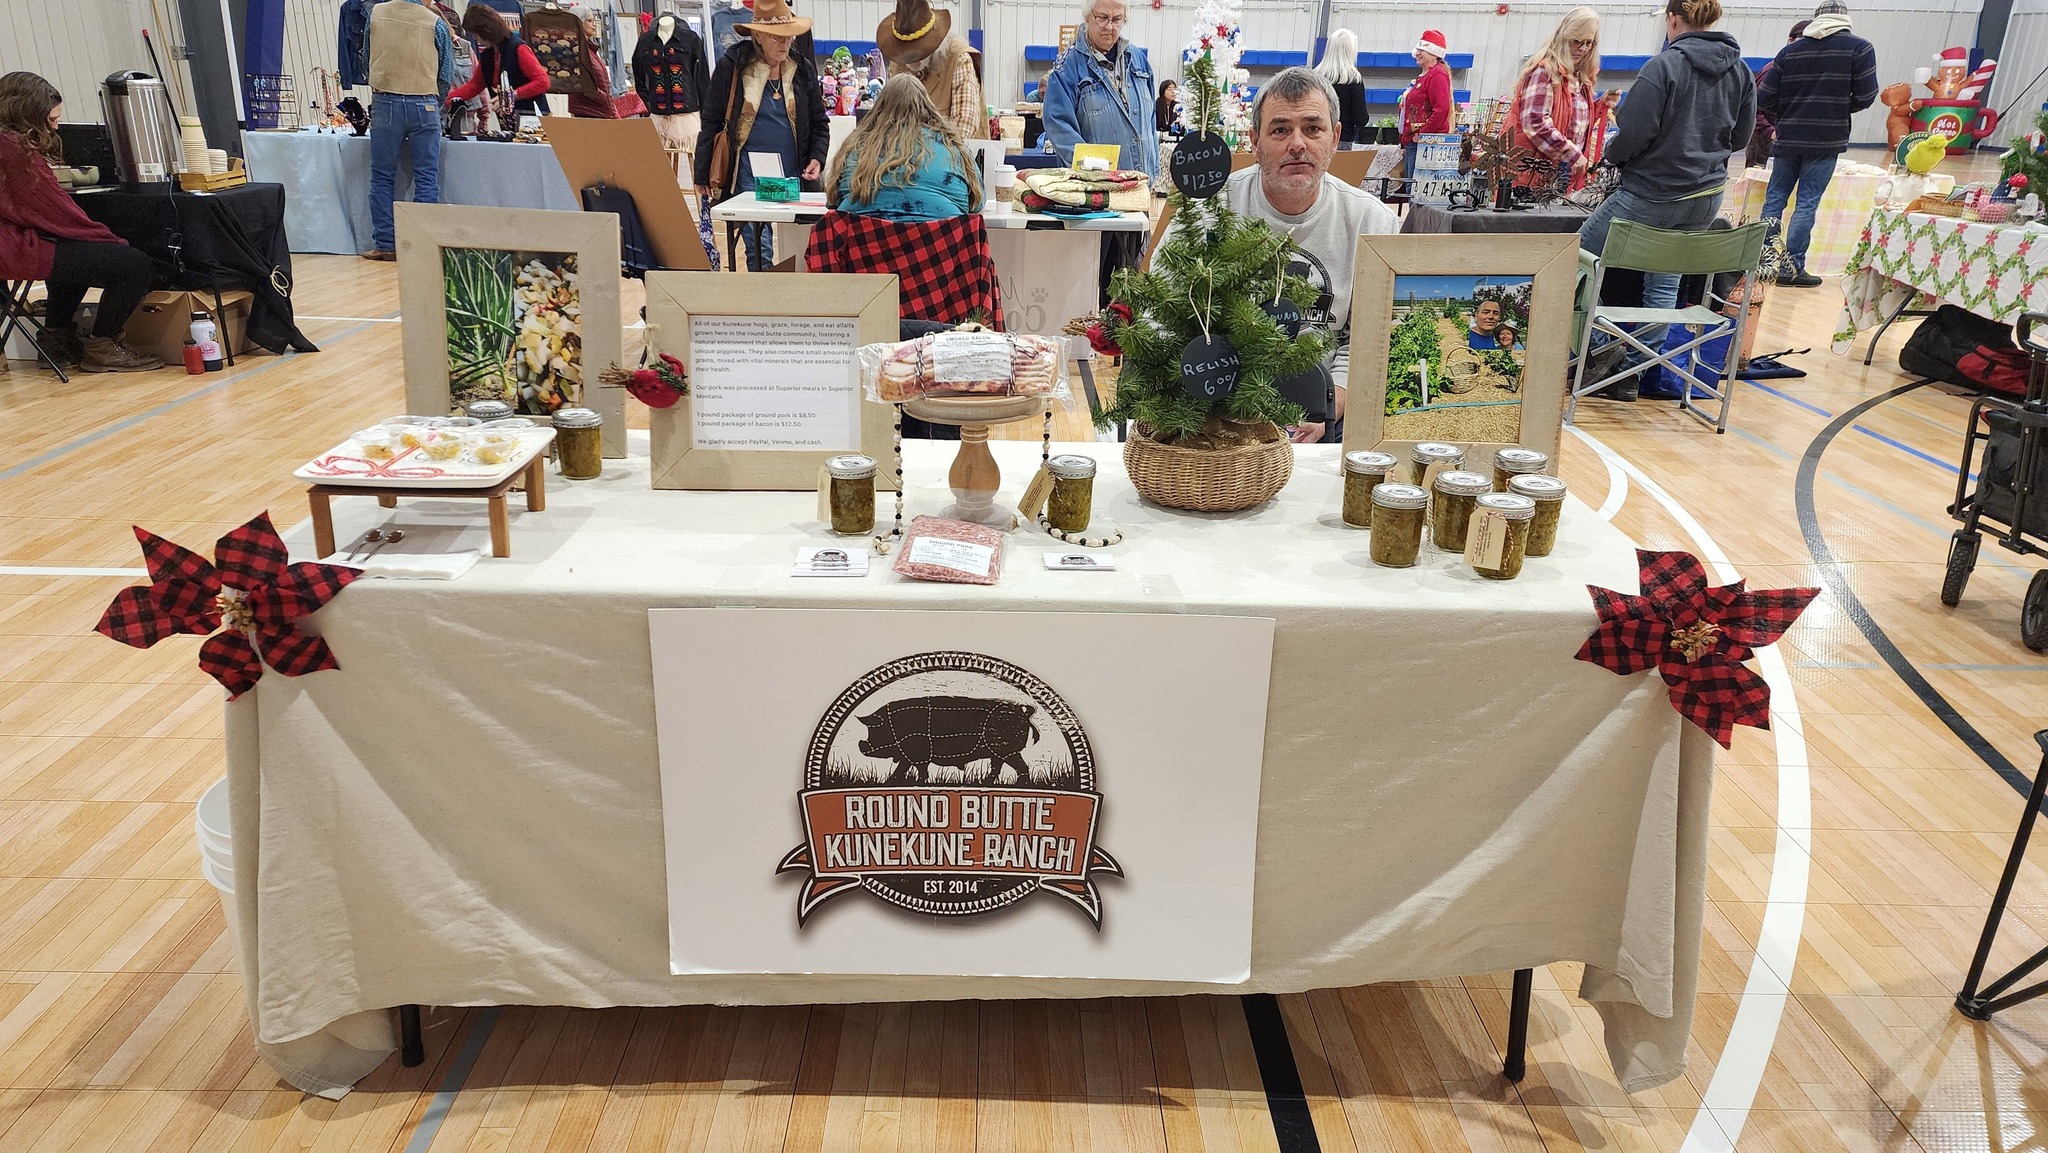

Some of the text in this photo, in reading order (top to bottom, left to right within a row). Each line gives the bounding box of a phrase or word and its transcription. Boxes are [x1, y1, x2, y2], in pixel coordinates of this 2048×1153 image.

[1936, 118, 1956, 129] Hot
[1932, 127, 1957, 137] Cocoa
[1172, 145, 1222, 166] BACON
[1433, 173, 1466, 181] MONTANA
[753, 321, 769, 329] hogs,
[818, 331, 845, 339] fostering
[1183, 355, 1240, 376] RELISH
[721, 411, 746, 419] package
[721, 420, 746, 428] package
[844, 795, 1056, 831] ROUND BUTTE
[824, 832, 1077, 873] KUNEKUNE RANCH
[923, 880, 978, 895] EST. 2014
